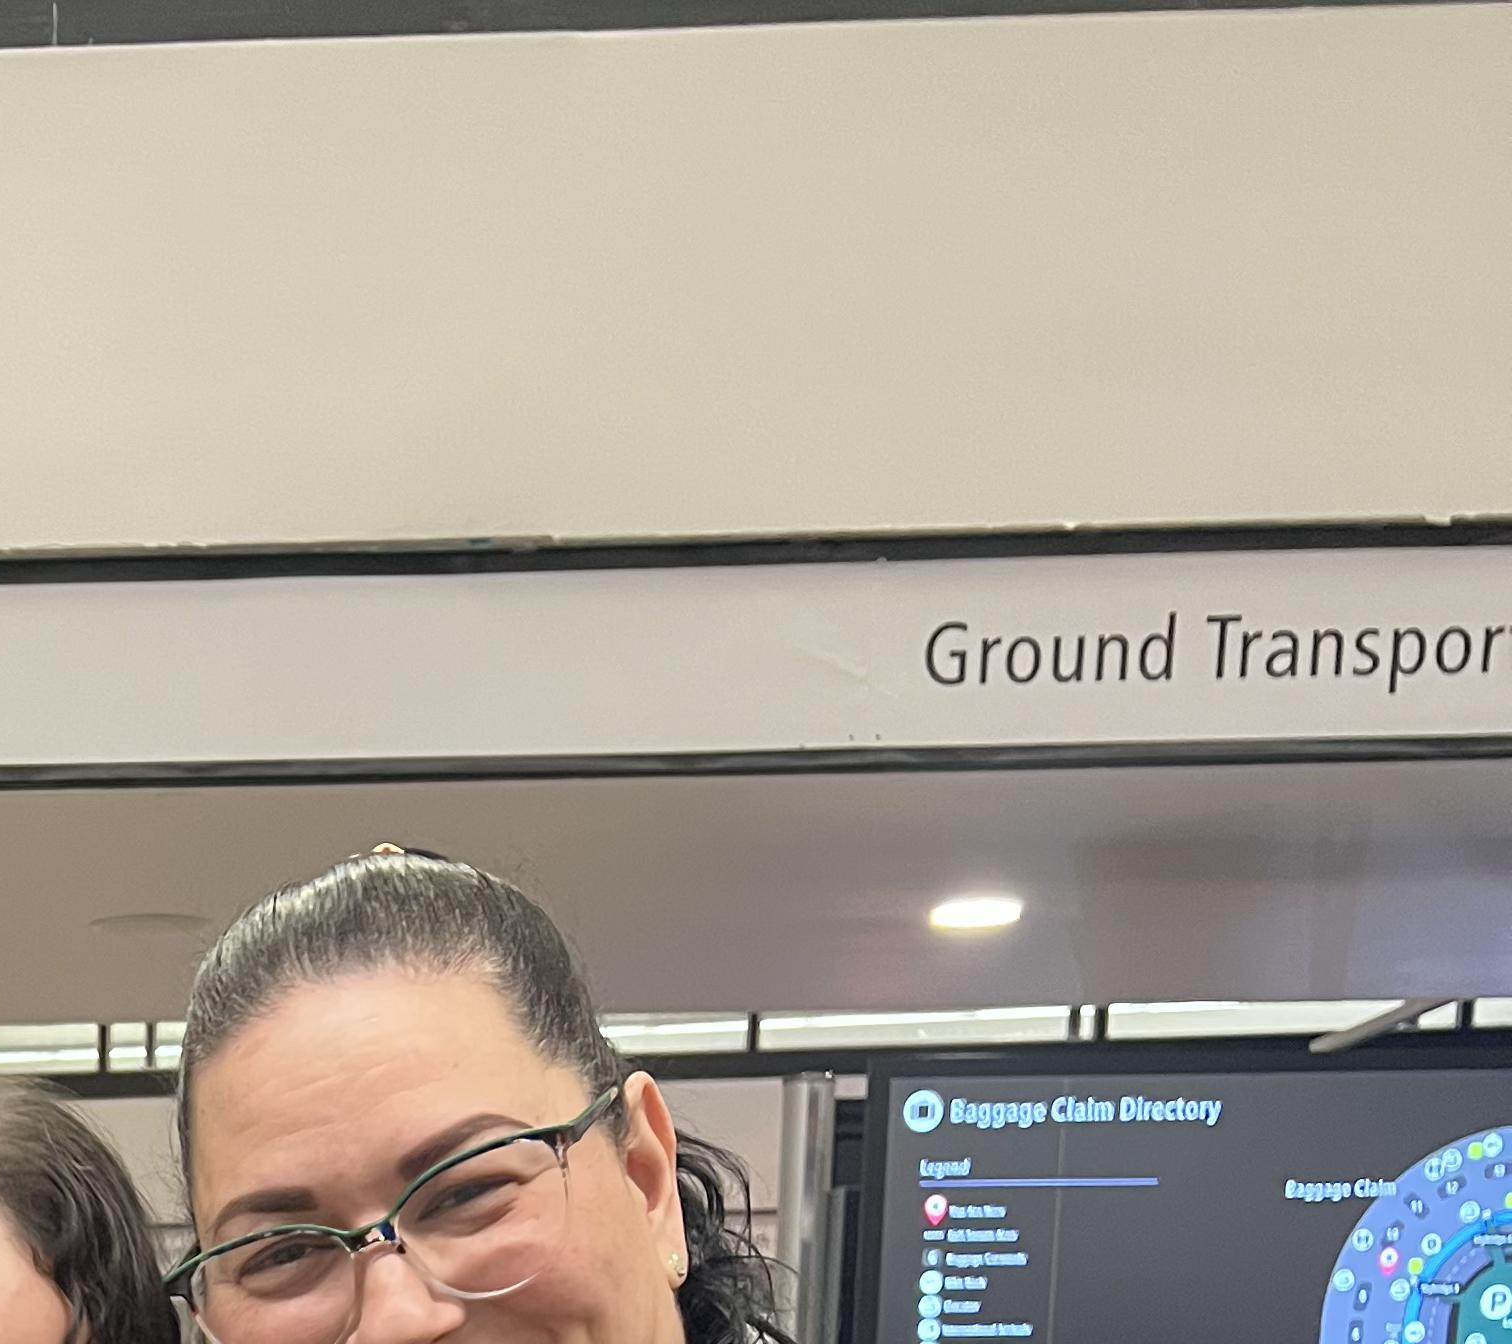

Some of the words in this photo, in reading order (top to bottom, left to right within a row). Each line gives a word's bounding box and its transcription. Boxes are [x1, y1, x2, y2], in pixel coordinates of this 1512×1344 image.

[924, 610, 1178, 686] Ground
[1205, 613, 1512, 694] Transpor
[949, 1098, 1047, 1129] Baggage
[1050, 1096, 1115, 1123] Claim
[1119, 1096, 1223, 1127] Directory
[919, 1157, 971, 1179] Legend
[1284, 1179, 1351, 1202] Baggage
[1353, 1178, 1397, 1198] Claim
[1491, 1291, 1506, 1312] P
